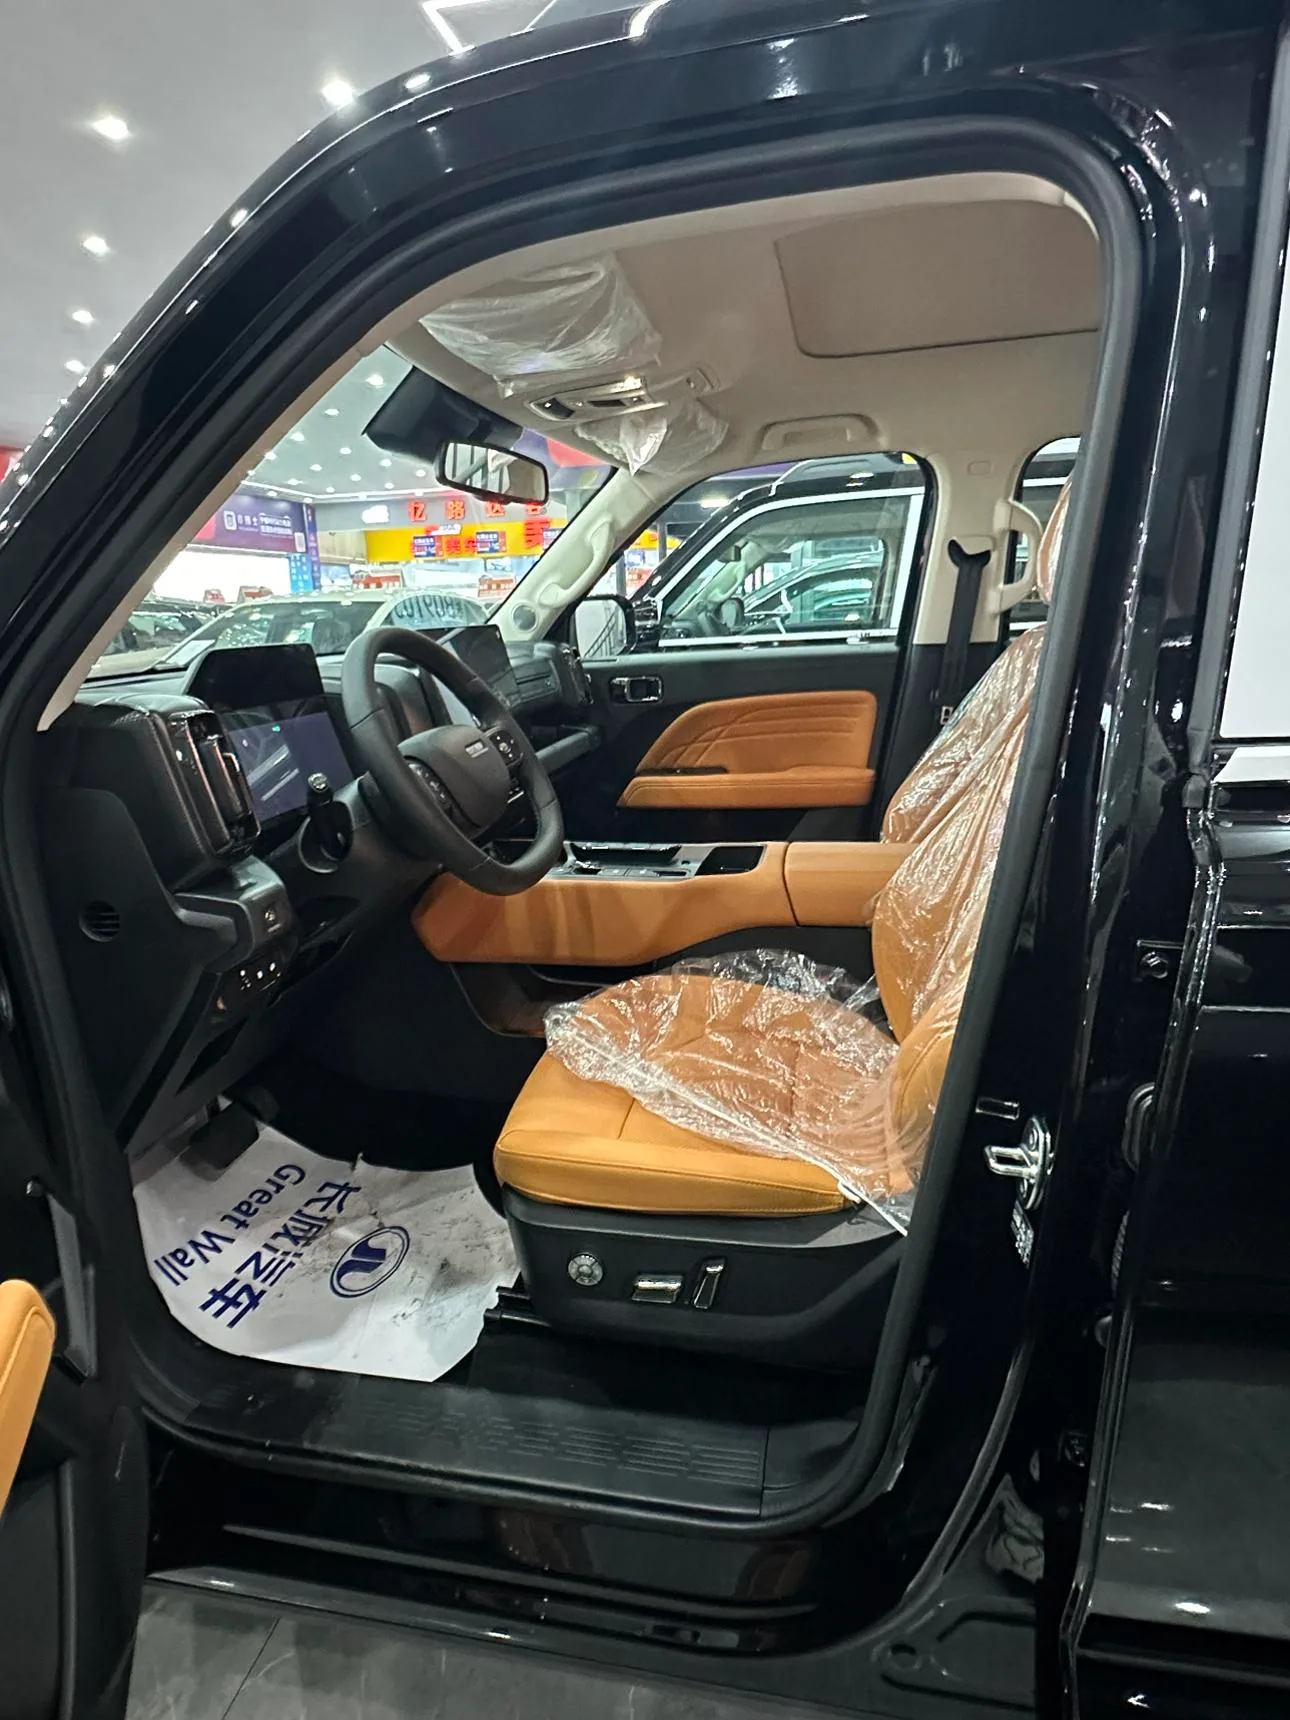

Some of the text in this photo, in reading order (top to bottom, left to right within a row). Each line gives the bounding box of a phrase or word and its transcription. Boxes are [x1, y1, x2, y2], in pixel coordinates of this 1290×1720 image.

[153, 1163, 306, 1287] Great Wall
[198, 1180, 362, 1329] 长城汽车
